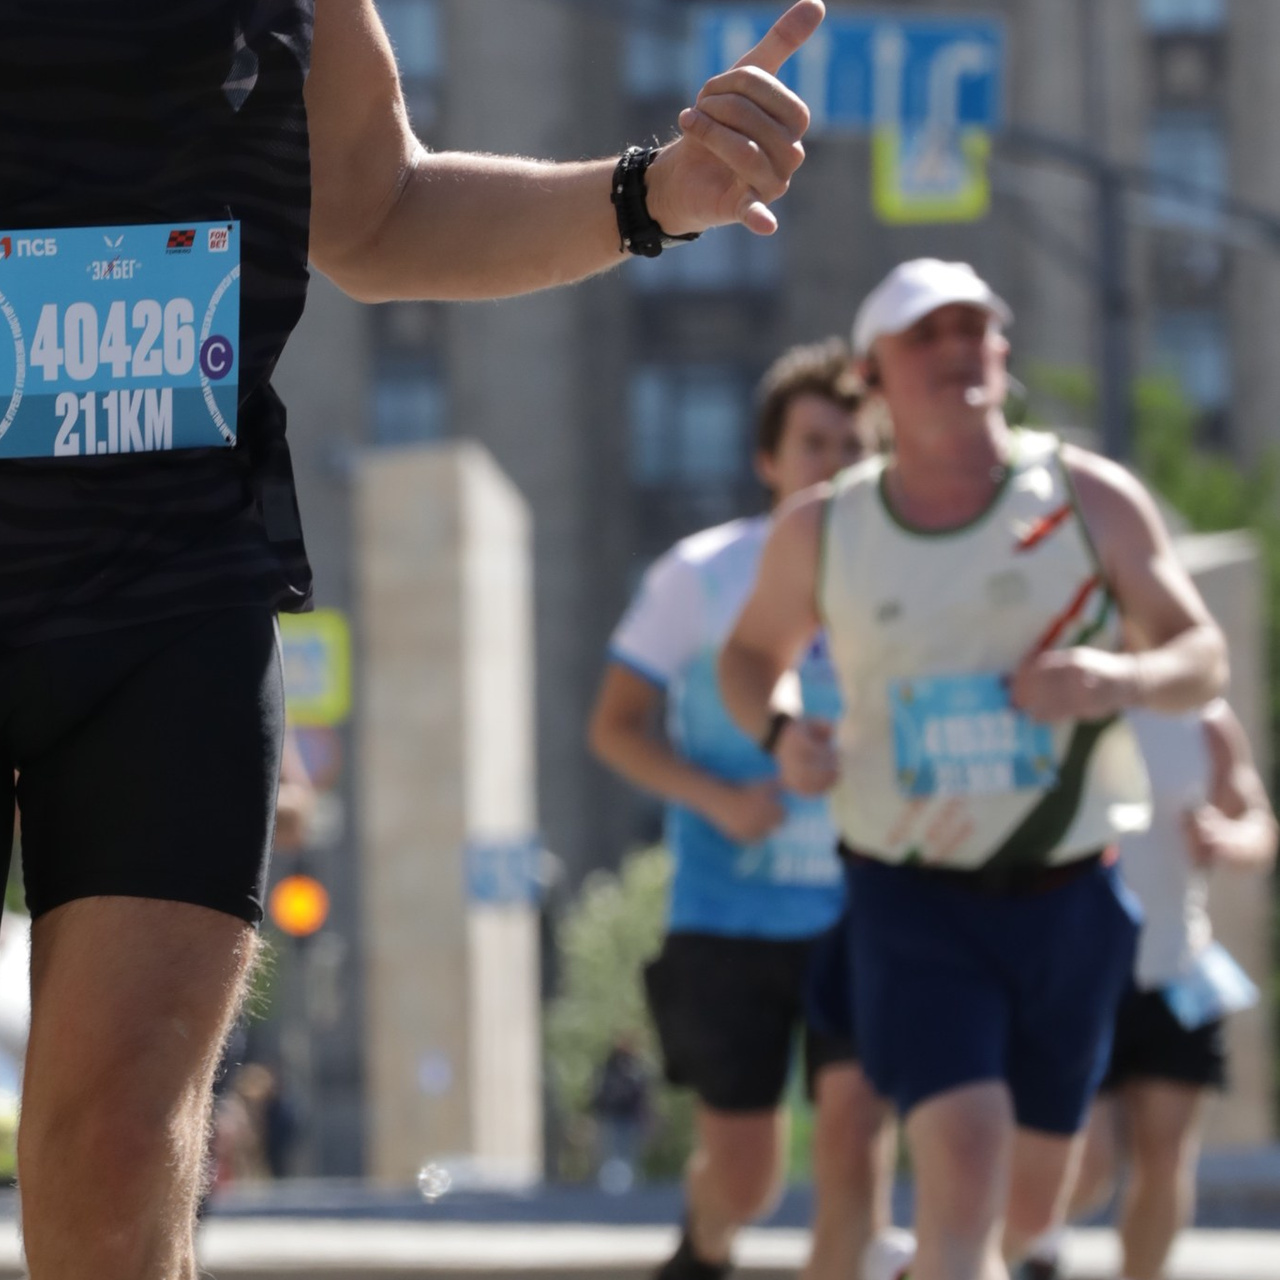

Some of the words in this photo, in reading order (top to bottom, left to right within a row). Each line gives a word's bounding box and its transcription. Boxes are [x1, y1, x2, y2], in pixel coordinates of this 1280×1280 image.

[209, 231, 228, 241] FON
[17, 238, 58, 257] ПСБ
[209, 240, 227, 250] BET
[30, 297, 195, 382] 40426
